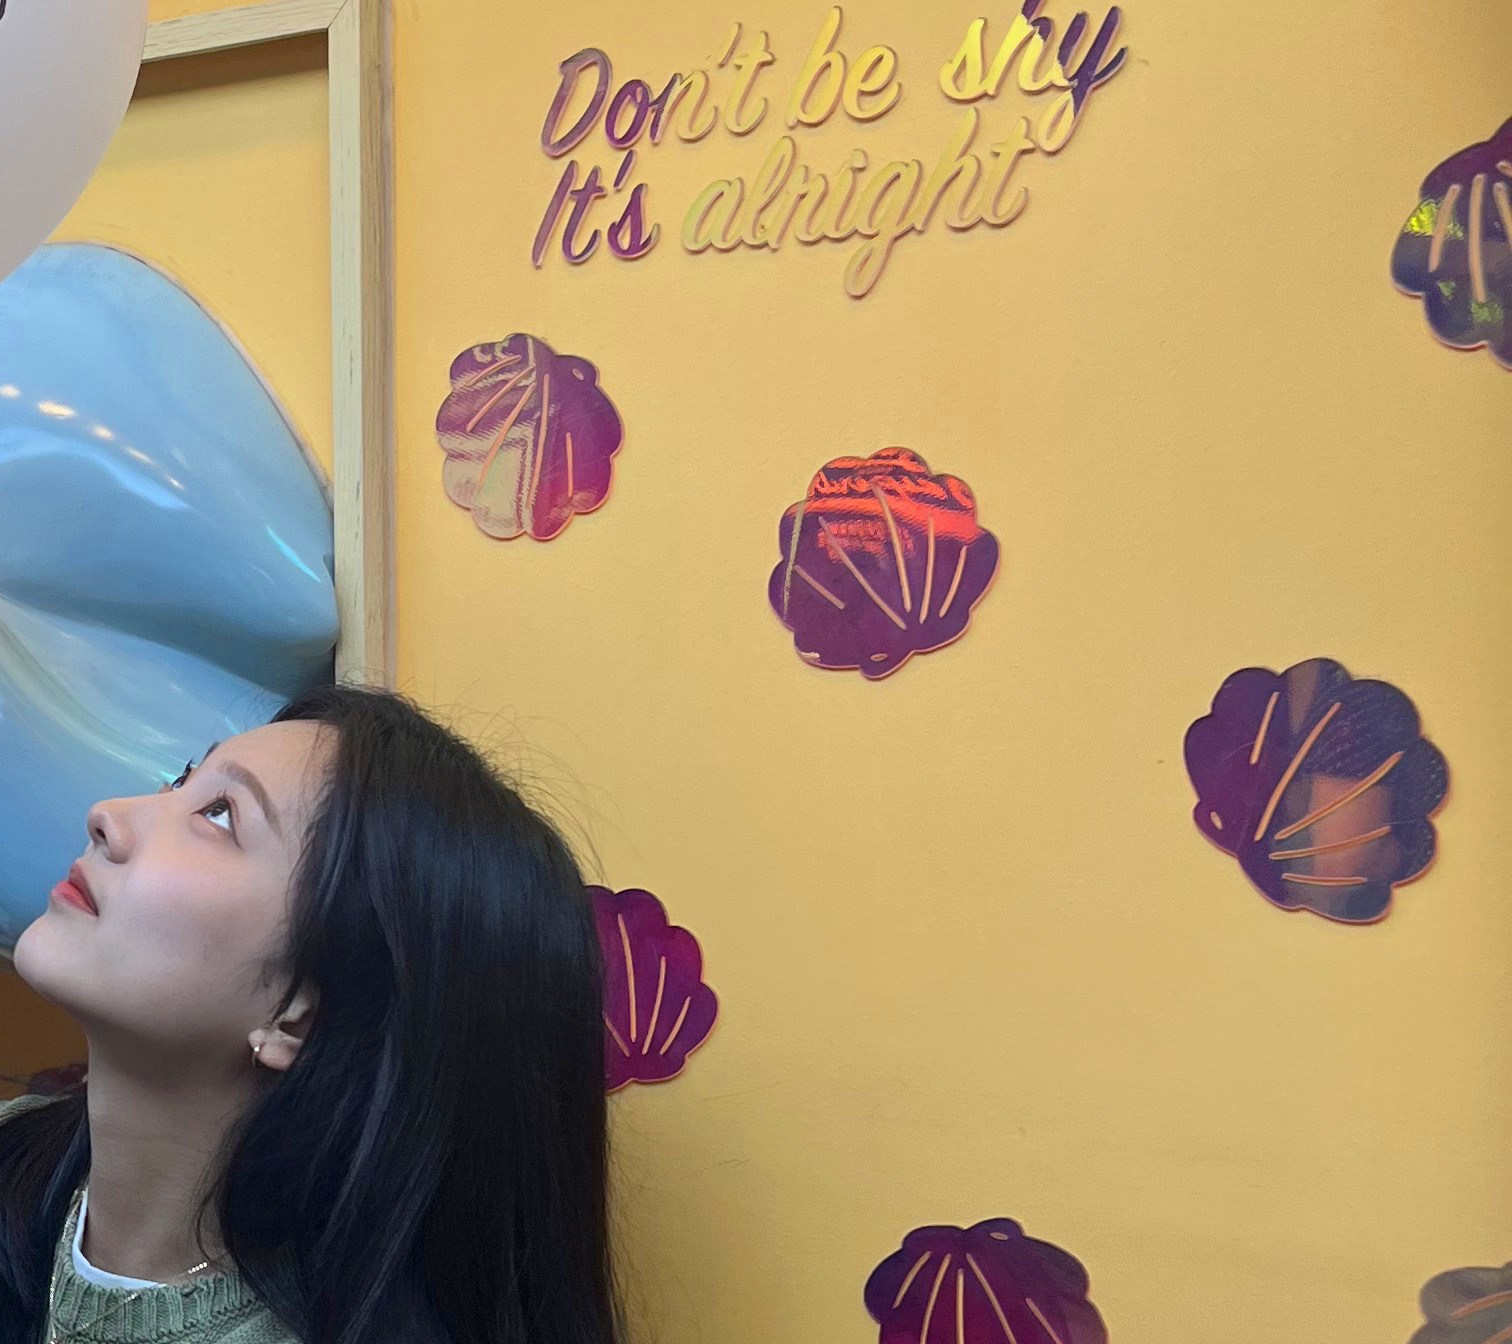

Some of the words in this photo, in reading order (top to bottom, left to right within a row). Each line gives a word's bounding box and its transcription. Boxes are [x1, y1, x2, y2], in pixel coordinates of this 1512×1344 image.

[541, 22, 776, 157] Don't
[787, 5, 903, 128] be
[531, 149, 661, 268] It's
[681, 107, 1036, 299] alright
